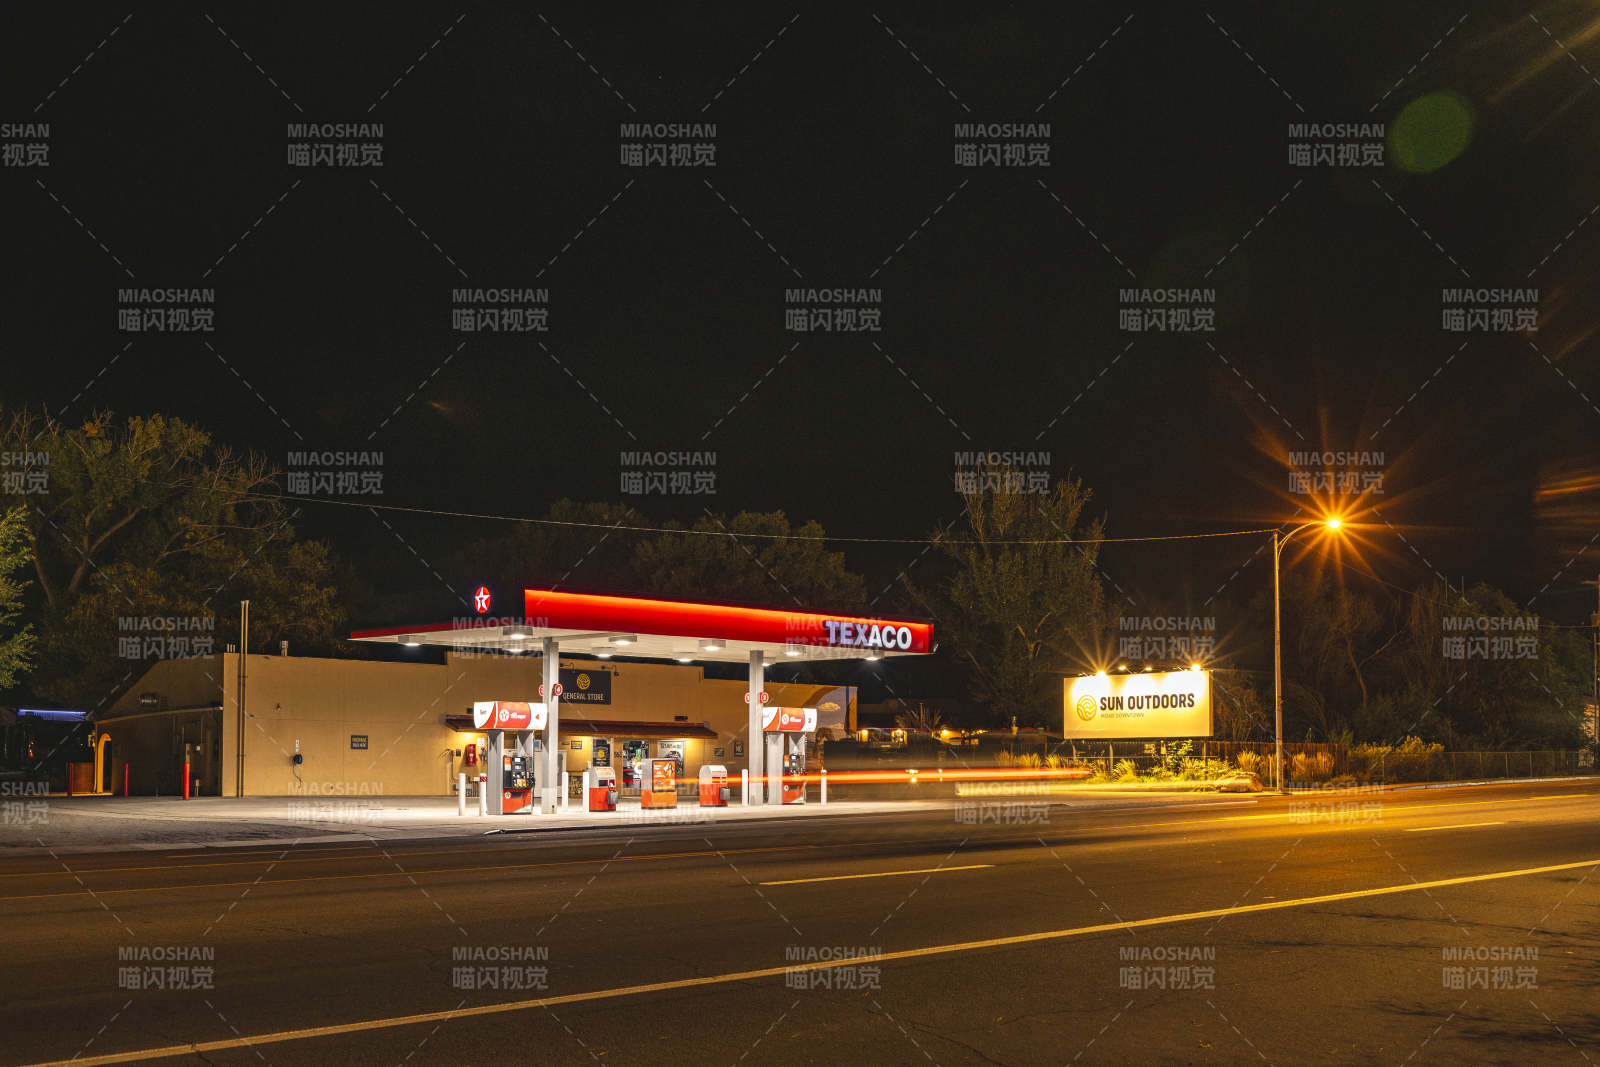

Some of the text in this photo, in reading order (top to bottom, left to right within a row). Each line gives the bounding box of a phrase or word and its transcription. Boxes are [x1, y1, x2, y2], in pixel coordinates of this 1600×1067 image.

[825, 620, 912, 650] TEXACO
[562, 692, 604, 701] GENERAL STORE
[1100, 693, 1195, 711] SUN OUTDOORS
